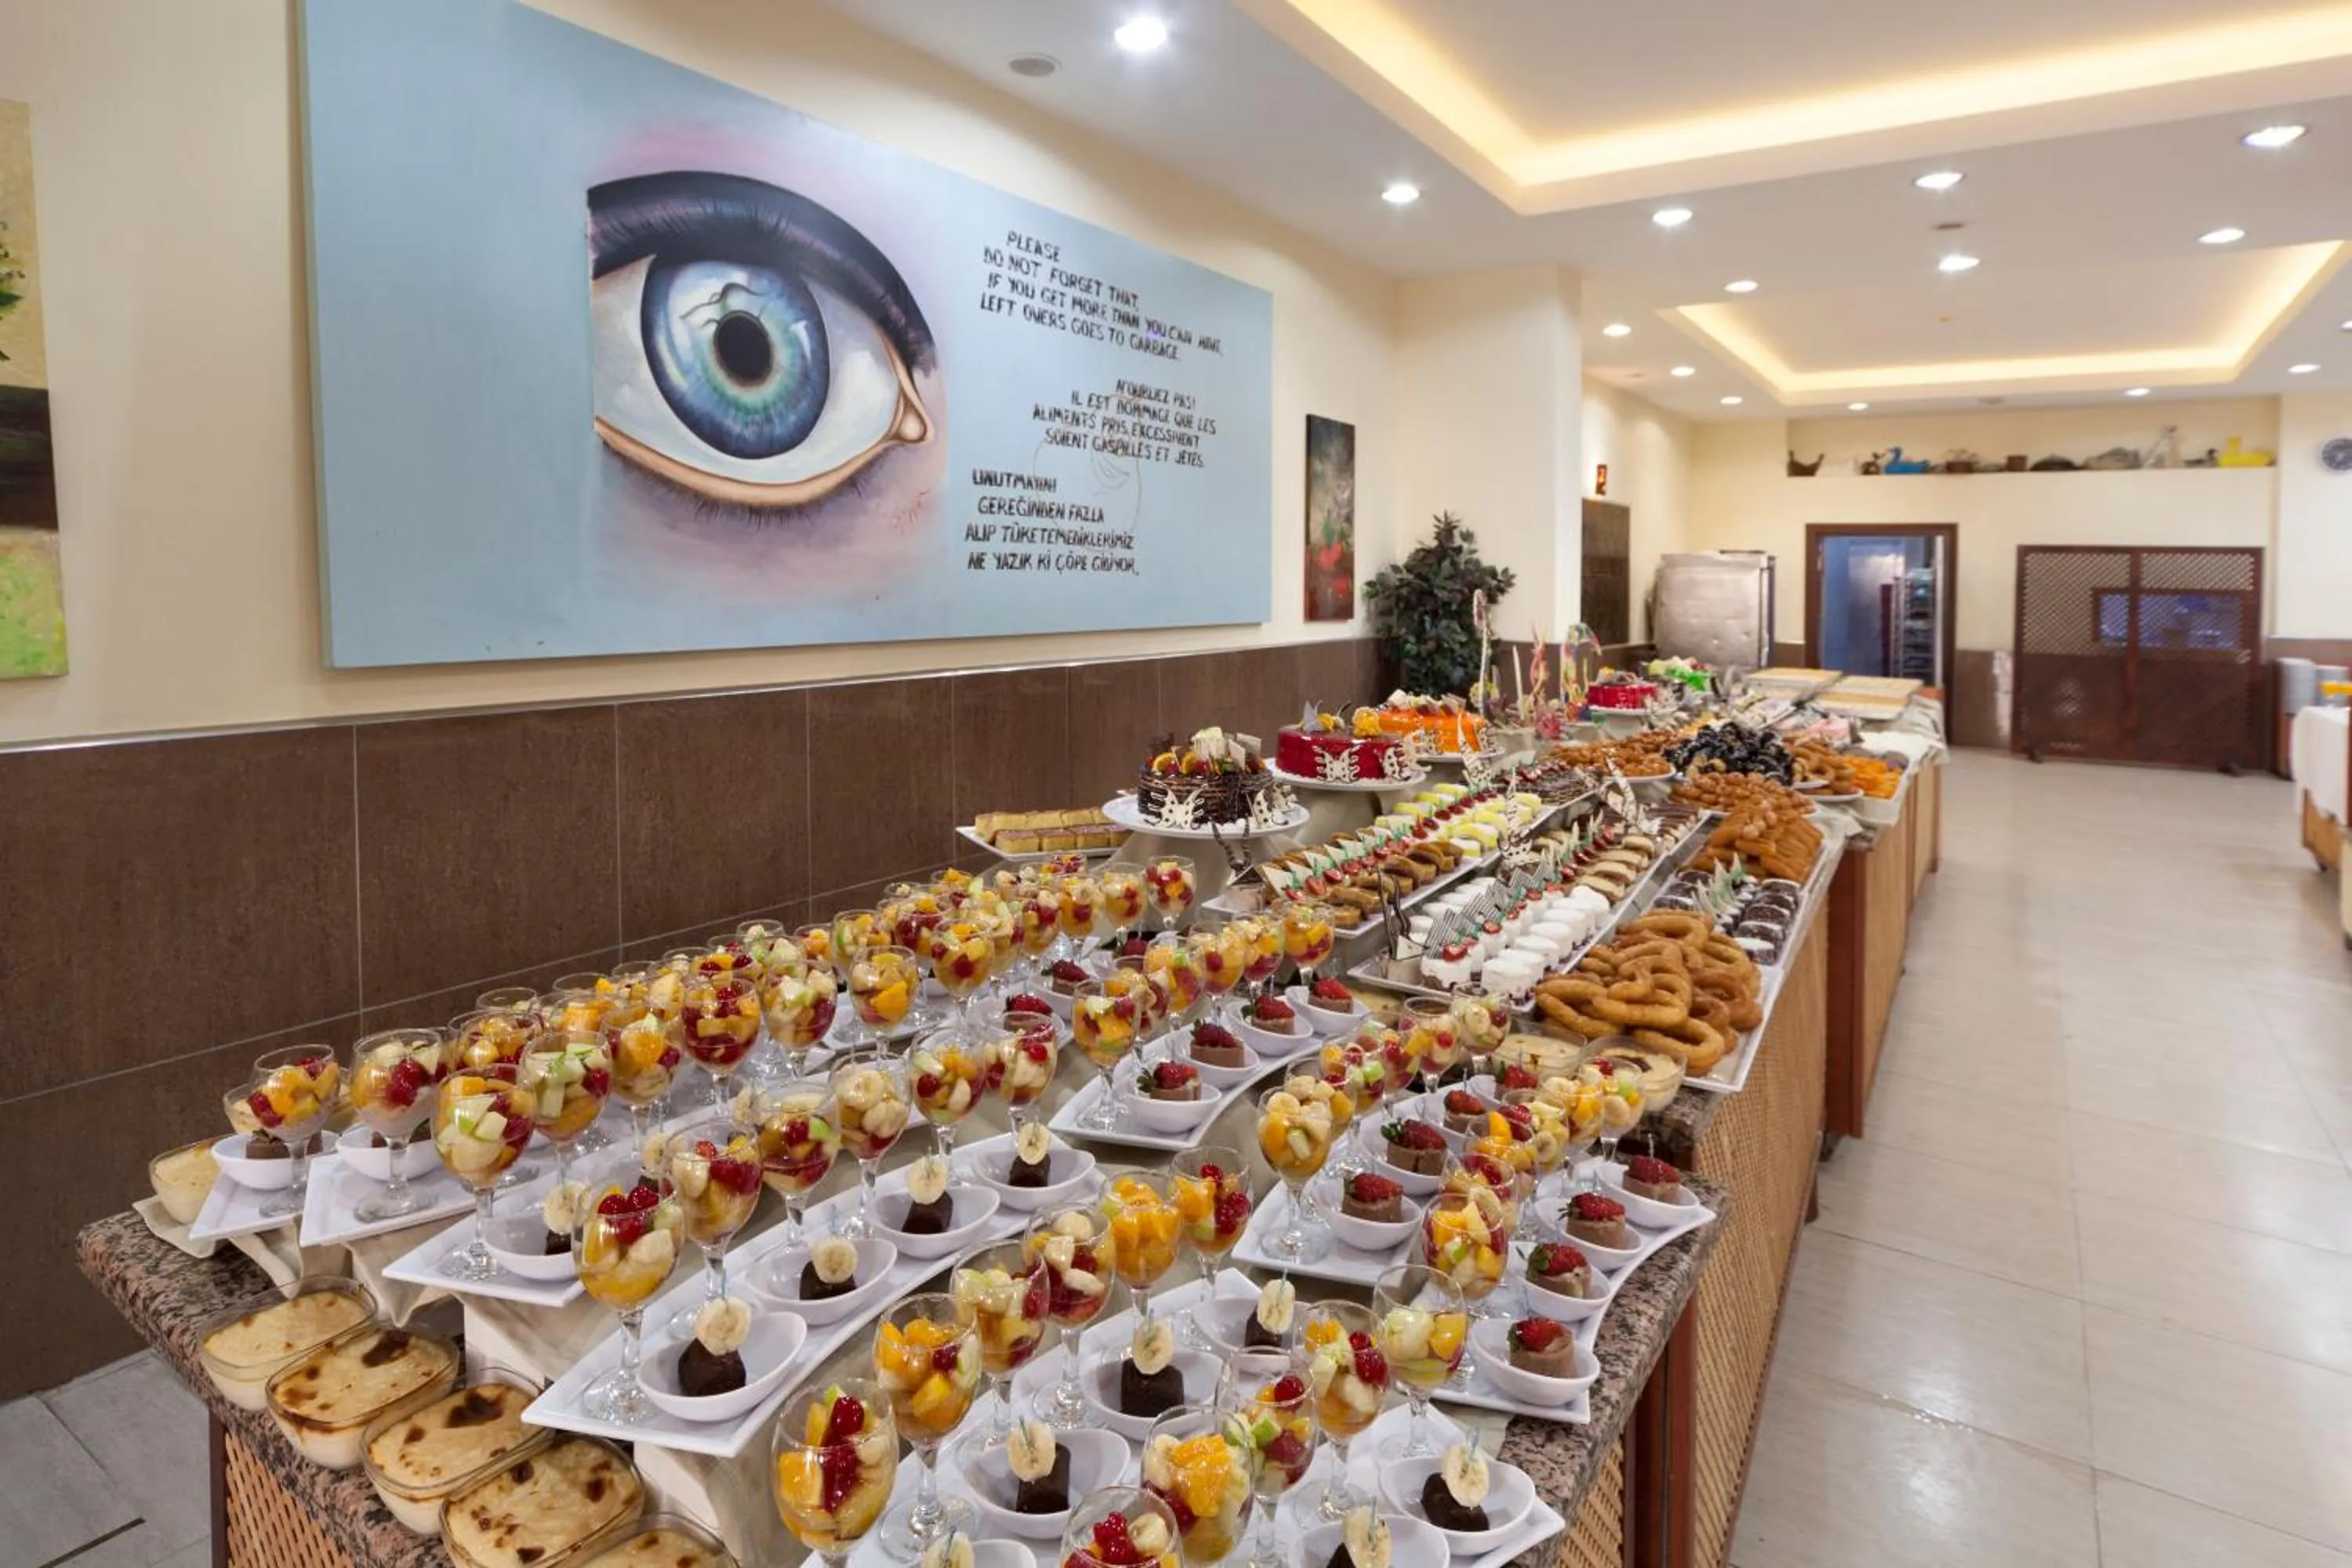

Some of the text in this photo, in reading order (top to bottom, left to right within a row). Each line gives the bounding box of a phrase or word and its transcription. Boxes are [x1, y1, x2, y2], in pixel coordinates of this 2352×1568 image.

[1007, 231, 1061, 263] PLEASE
[983, 245, 1004, 267] DO
[1008, 256, 1042, 275] NOT
[1049, 267, 1104, 296] FORGET
[980, 292, 1016, 316] LEFT
[1023, 304, 1066, 331] OVERS
[1071, 318, 1105, 342] GOES
[1109, 327, 1125, 347] TO
[987, 273, 1000, 289] IF
[1007, 276, 1035, 299] YOU
[1040, 287, 1066, 308] GET
[1072, 296, 1107, 321] MORE
[1112, 307, 1140, 328] THAN
[1145, 316, 1167, 338] YOU
[1033, 402, 1096, 430] ALIMENTS
[1102, 416, 1127, 435] PRIS
[1071, 390, 1217, 436] IL EST DOMMAGE QUE LES
[1044, 427, 1089, 450] SOIENT
[1155, 445, 1171, 463] ET
[1068, 503, 1105, 524] FAZLA
[964, 523, 996, 543] ALIP
[967, 551, 985, 570] NE
[992, 551, 1033, 571] YAZIK
